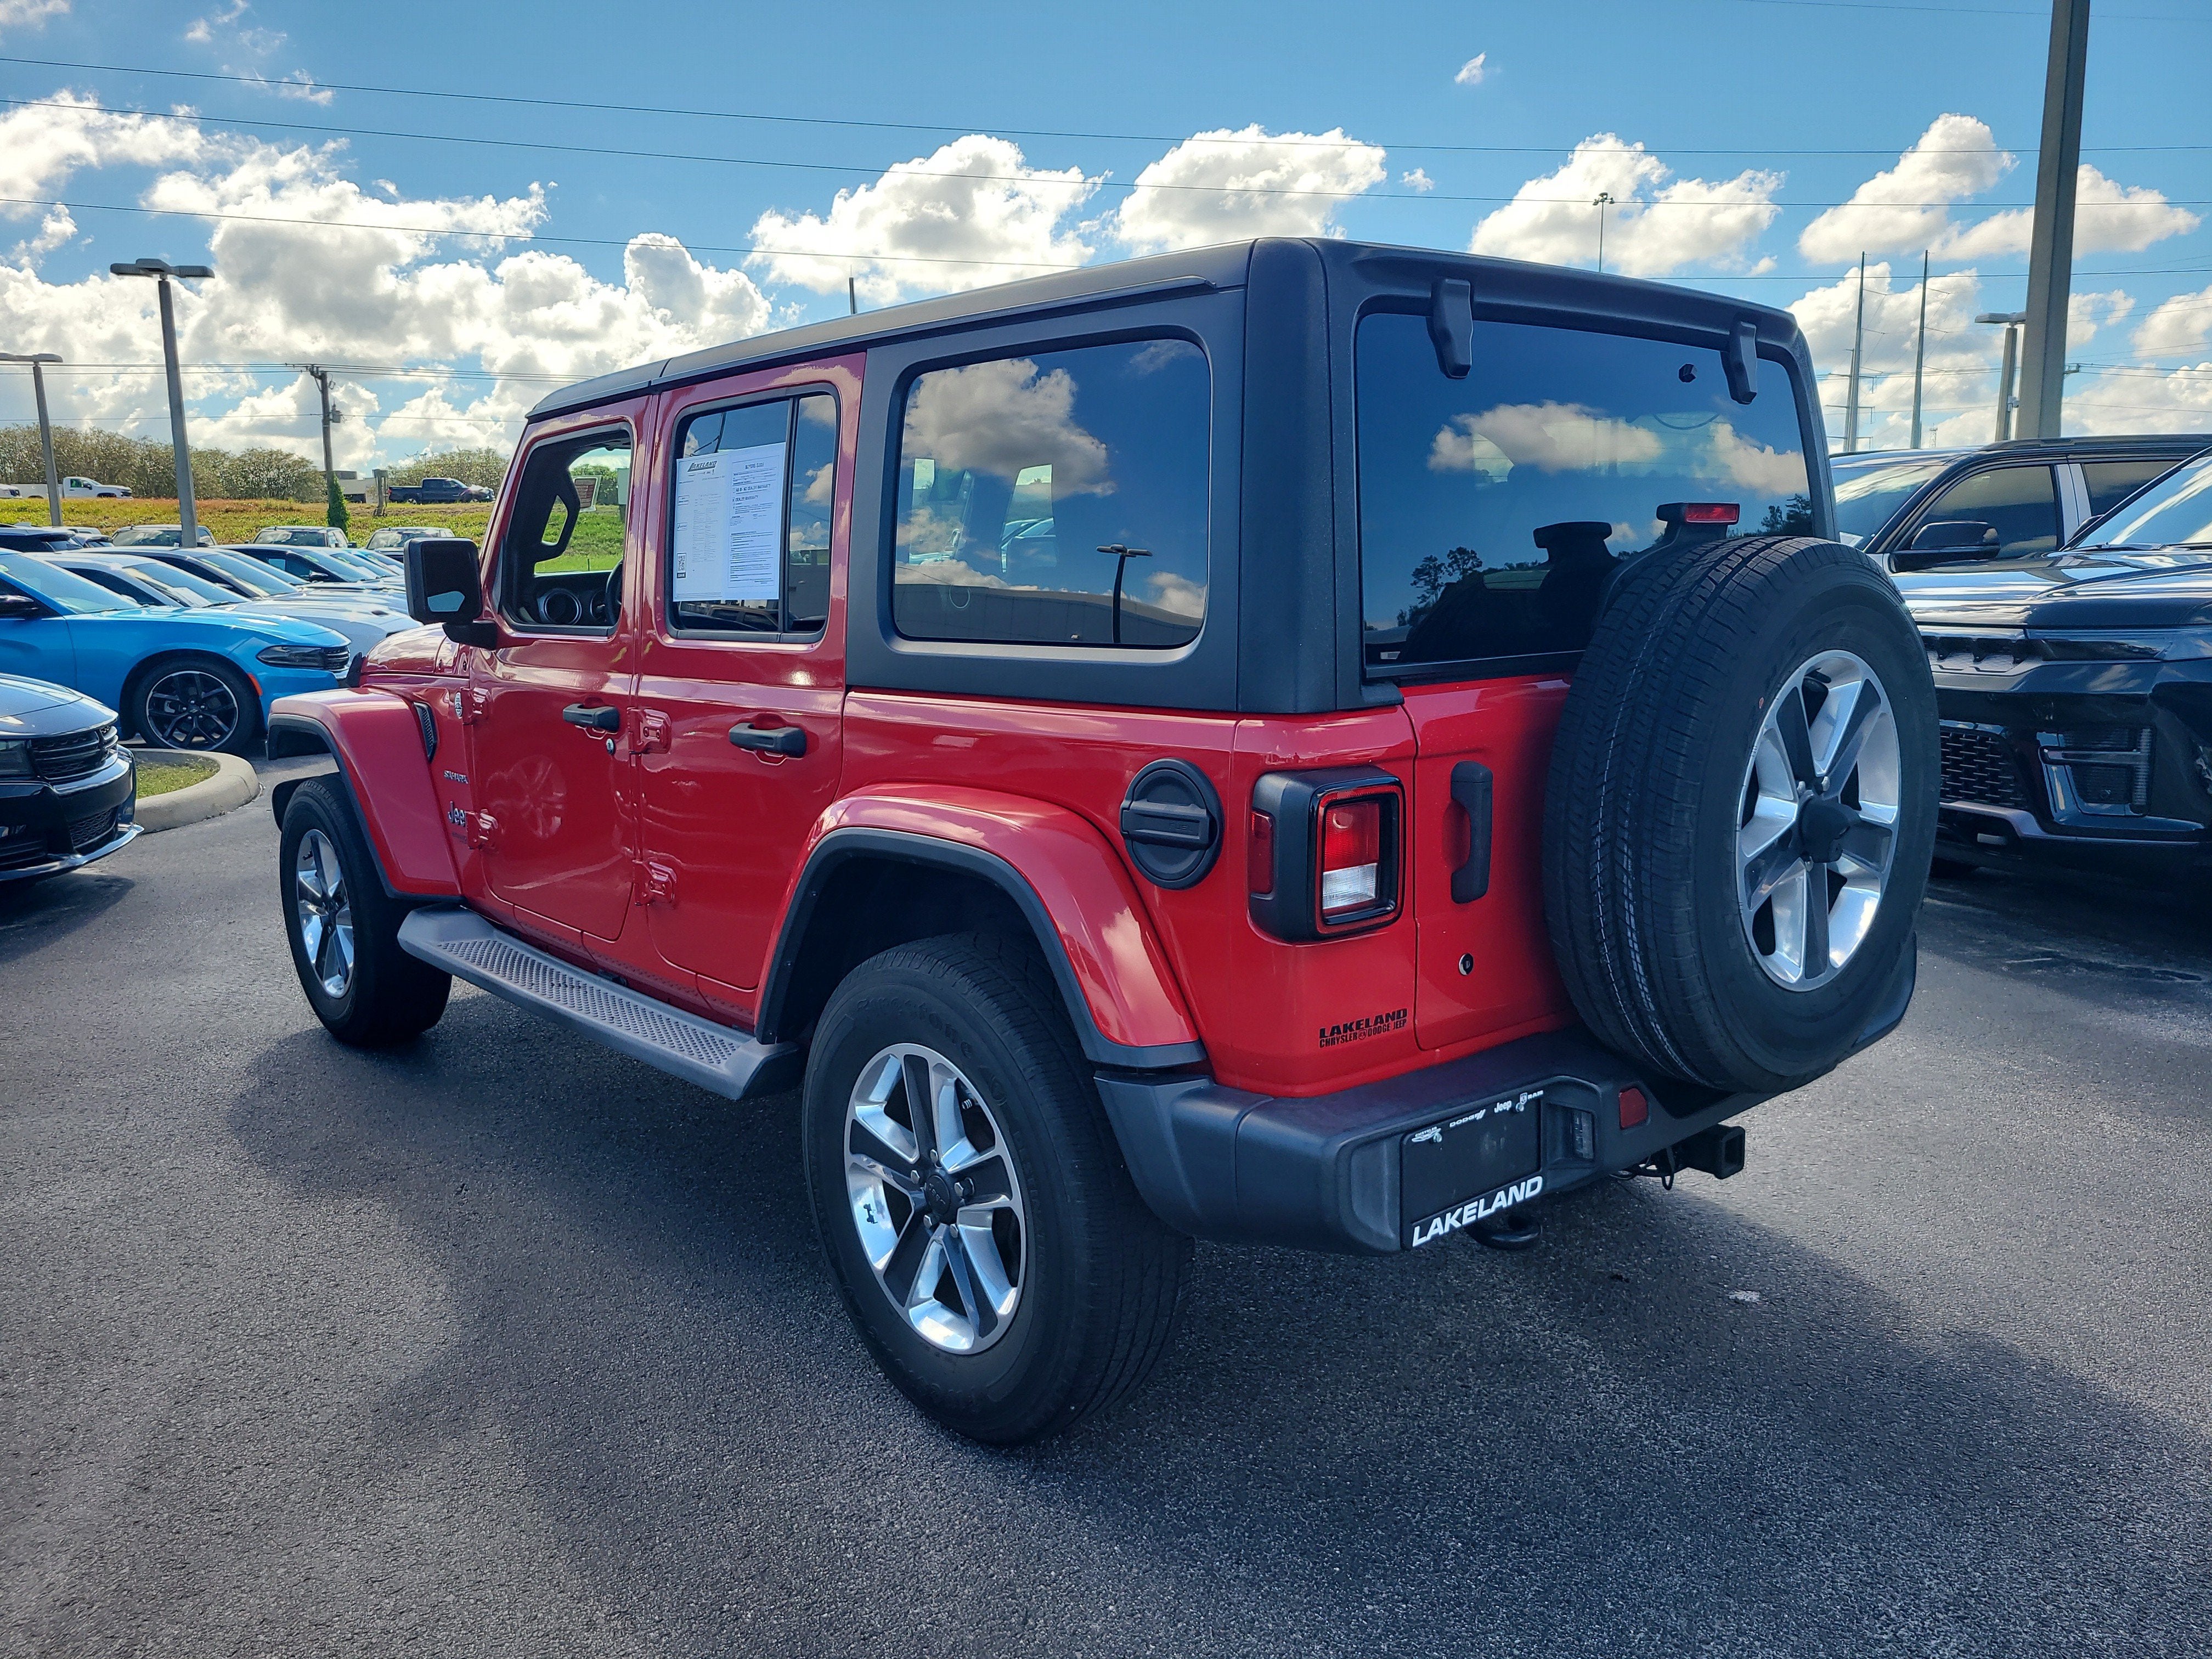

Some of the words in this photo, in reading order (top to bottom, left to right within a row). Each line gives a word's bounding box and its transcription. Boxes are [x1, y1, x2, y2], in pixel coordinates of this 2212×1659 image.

[443, 770, 469, 784] SAHARA
[1319, 1008, 1408, 1039] LAKELAND
[1319, 1032, 1358, 1048] CHRYSLER
[1368, 1023, 1390, 1037] DODGE
[1393, 1019, 1407, 1030] JEEP
[1528, 1090, 1544, 1099] RAM
[1494, 1100, 1512, 1113] Jeep
[1412, 1176, 1543, 1248] LAKELAND
